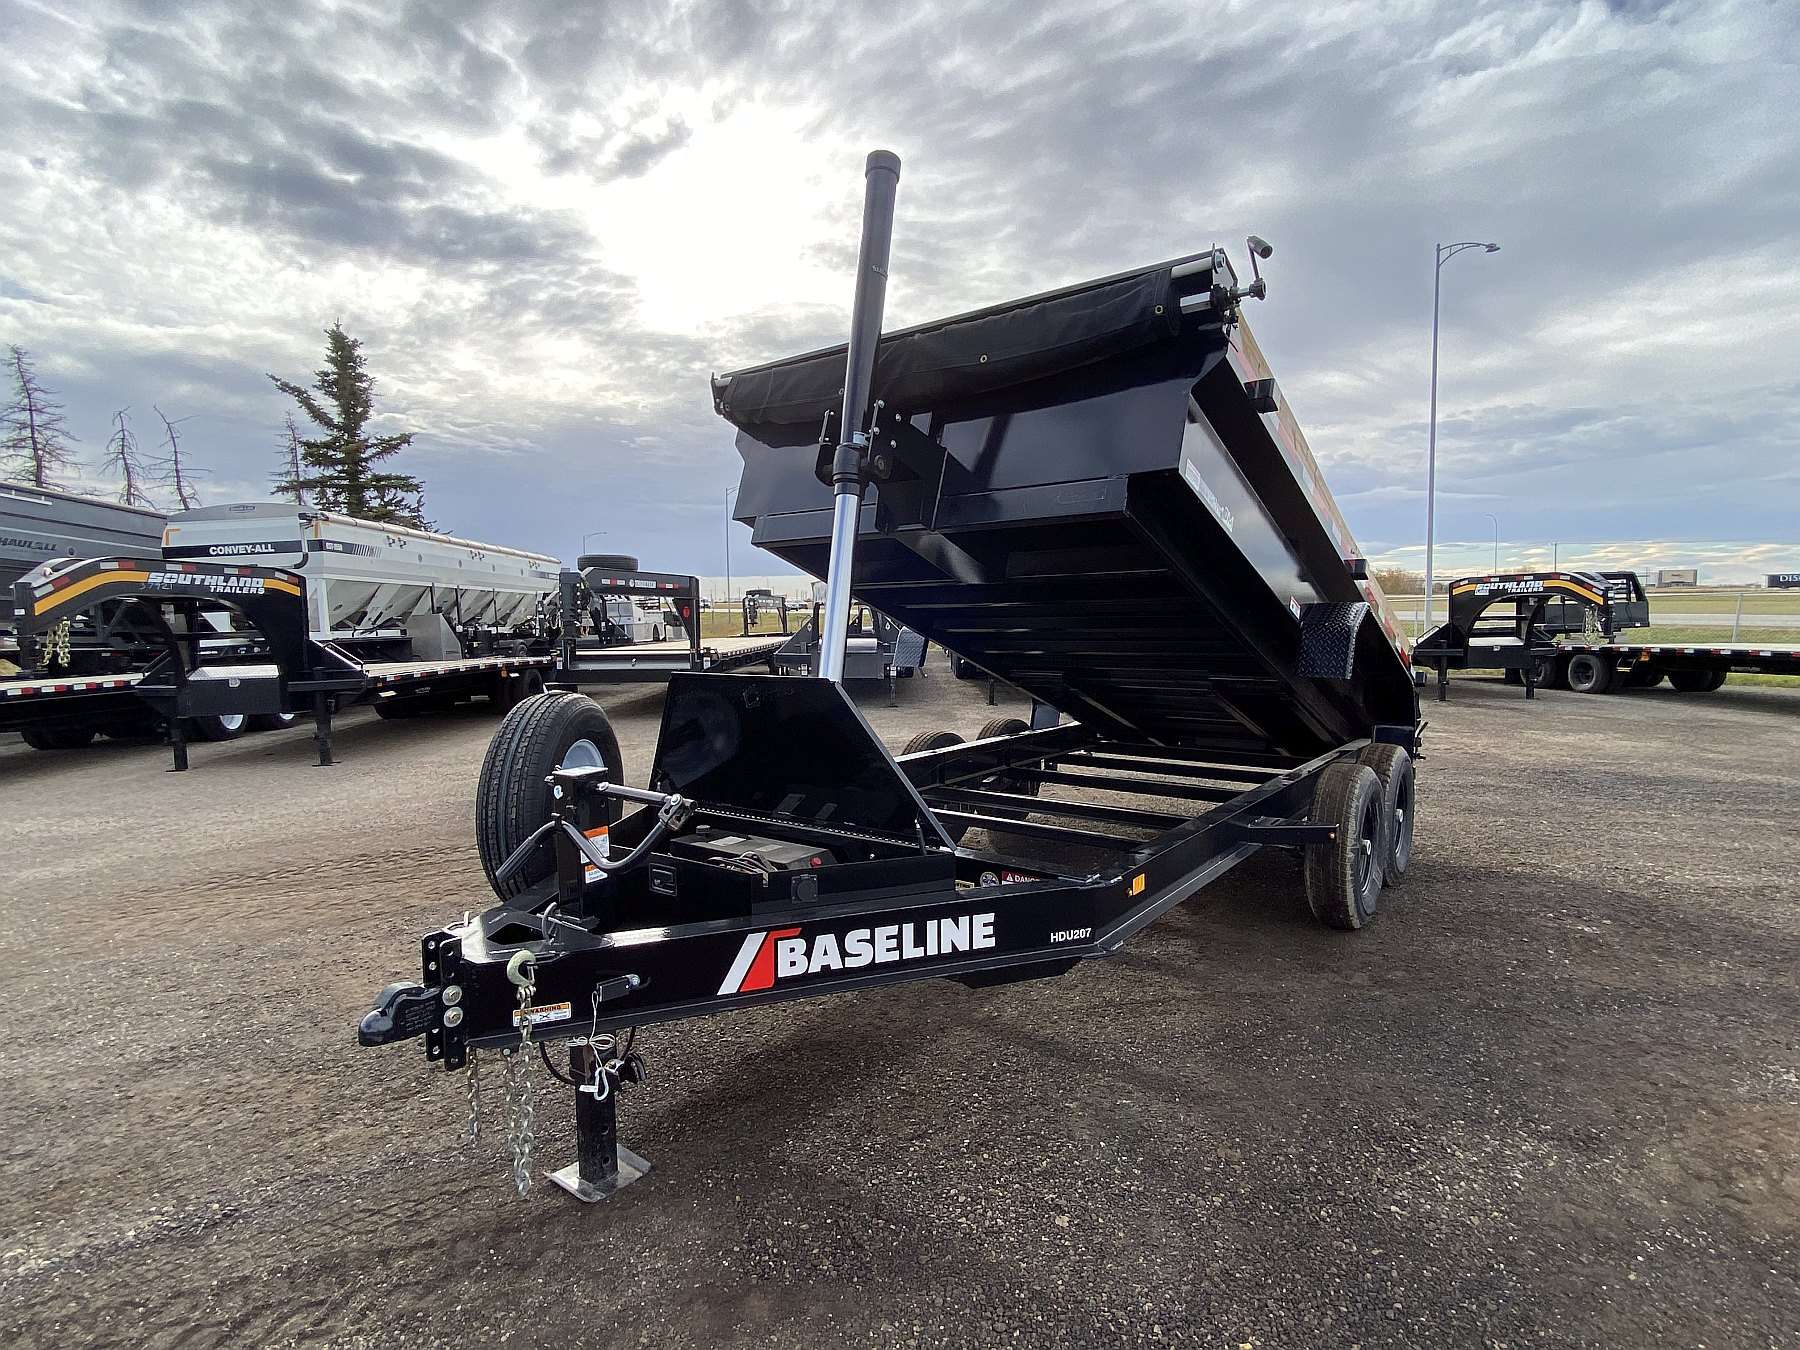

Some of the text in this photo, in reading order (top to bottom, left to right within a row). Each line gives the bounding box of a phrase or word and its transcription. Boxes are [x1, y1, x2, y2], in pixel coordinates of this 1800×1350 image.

[208, 543, 276, 555] CONVEY-ALL
[147, 572, 265, 588] SOUTHLAND
[1475, 580, 1544, 590] SOUTHLAND
[209, 584, 265, 595] TRAILERS
[1050, 927, 1092, 943] HDU207
[777, 912, 995, 978] BASELINE
